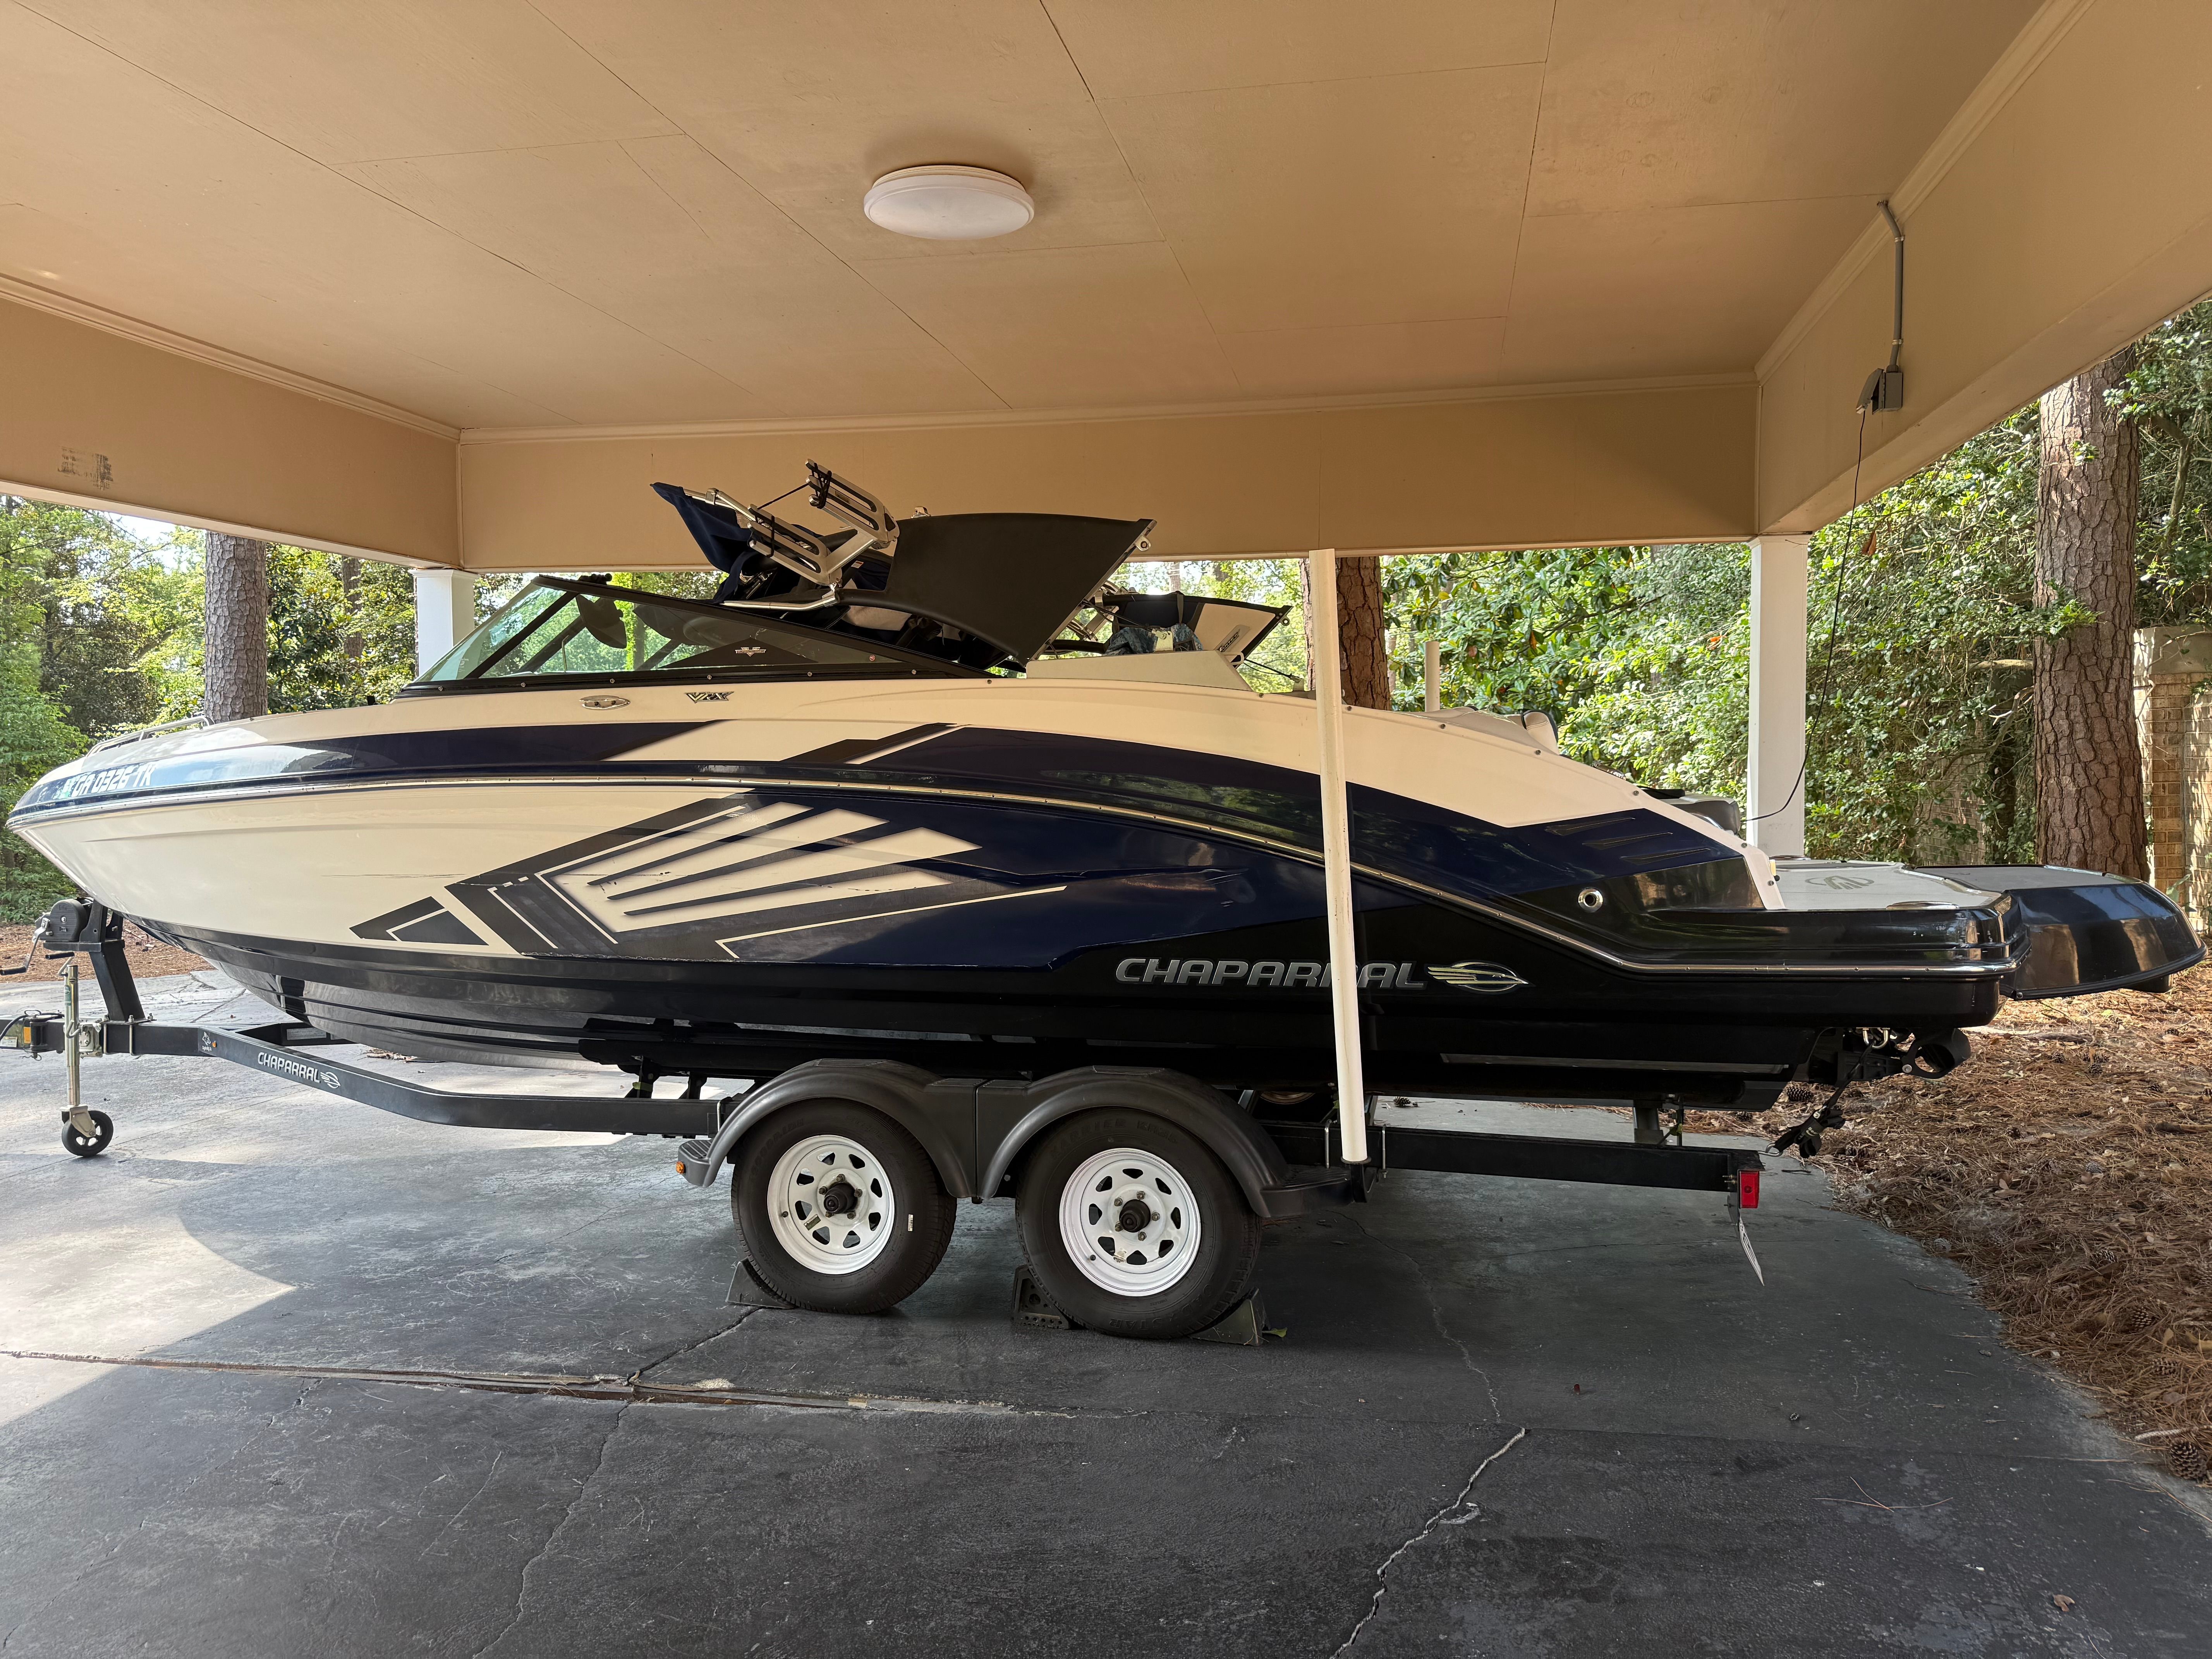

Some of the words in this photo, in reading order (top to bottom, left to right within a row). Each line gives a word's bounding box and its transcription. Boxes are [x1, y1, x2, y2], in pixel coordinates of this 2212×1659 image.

[71, 774, 96, 797] GA
[91, 765, 137, 793] 0326
[258, 1052, 320, 1084] CHAPARRAL
